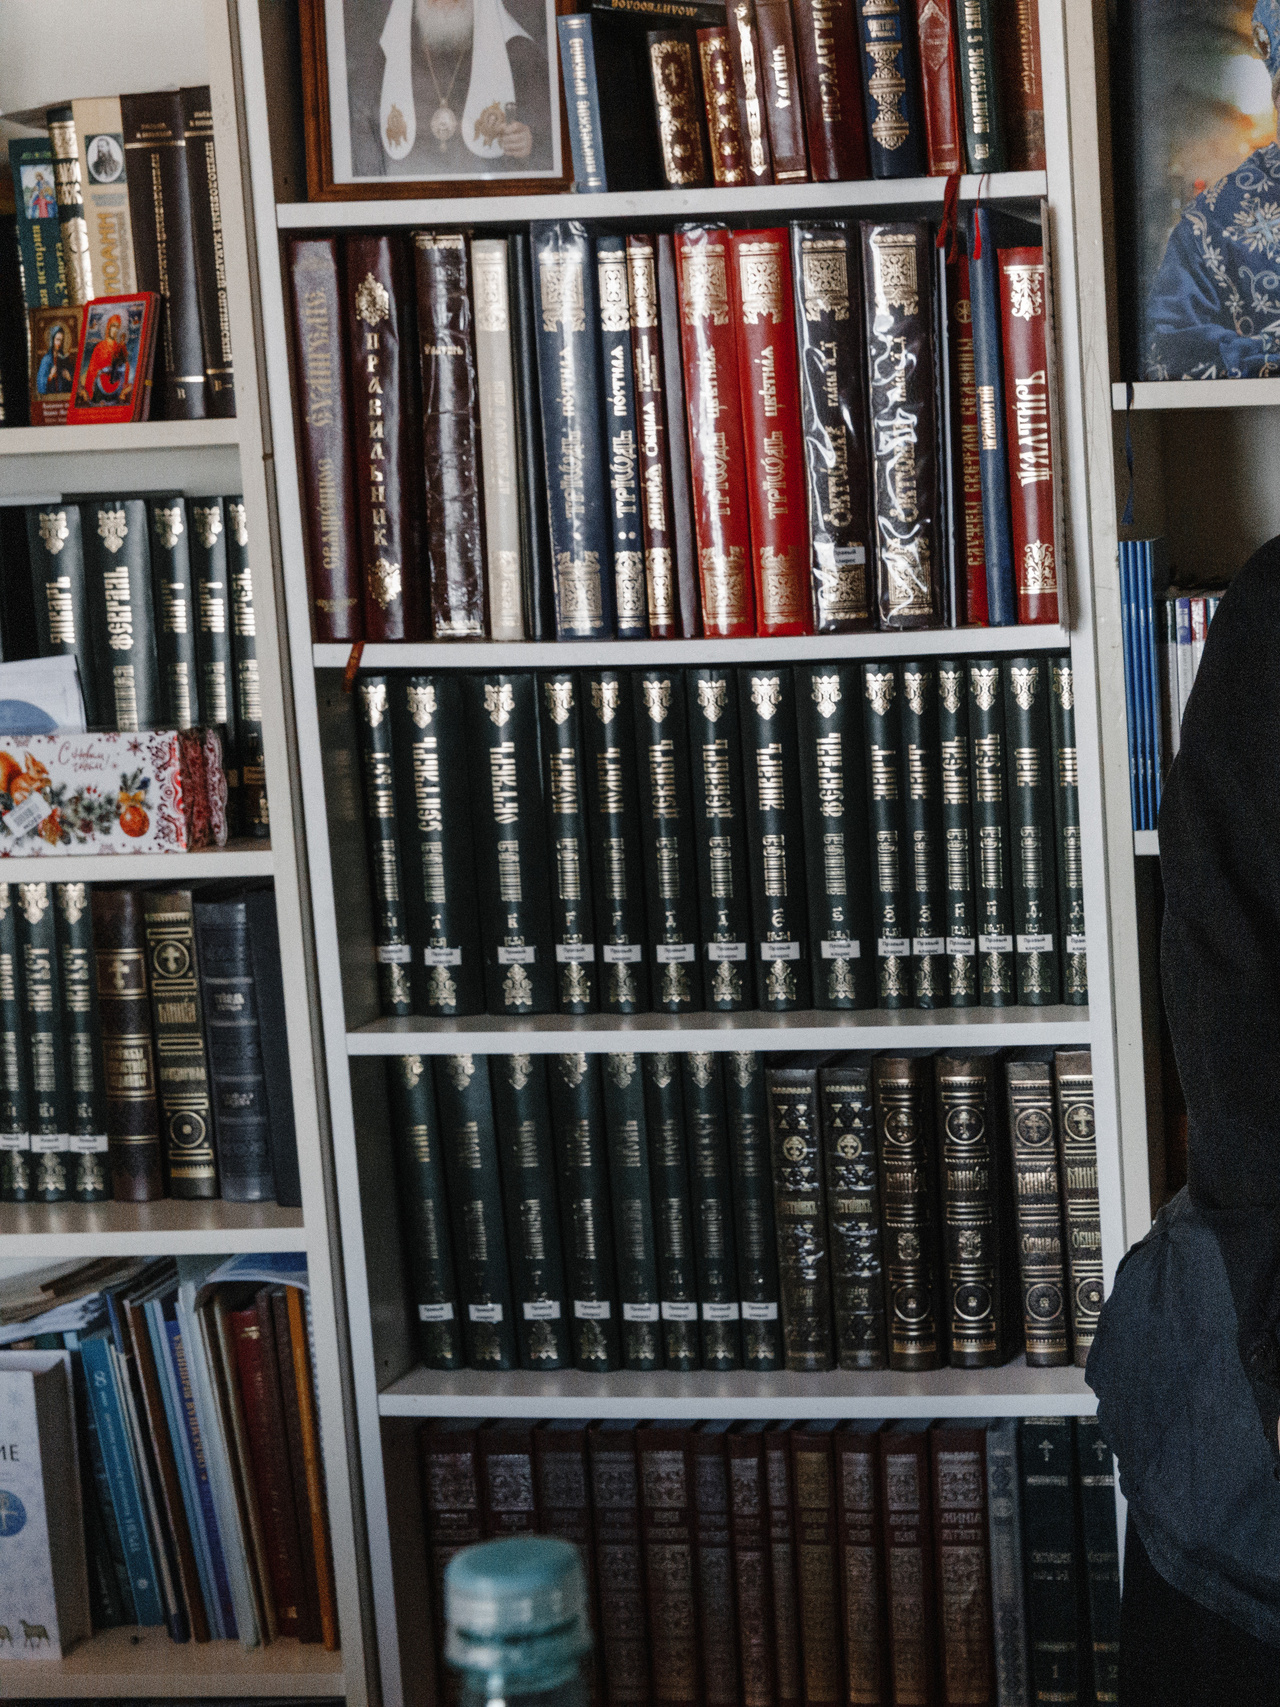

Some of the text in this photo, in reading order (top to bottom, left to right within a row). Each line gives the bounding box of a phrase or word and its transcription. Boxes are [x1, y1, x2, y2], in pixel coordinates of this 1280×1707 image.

[366, 332, 390, 547] ПРАВИЛЬНИК
[489, 741, 519, 825] ОКТЯБРЬ
[985, 936, 1008, 944] Правый
[1023, 936, 1046, 944] Правый
